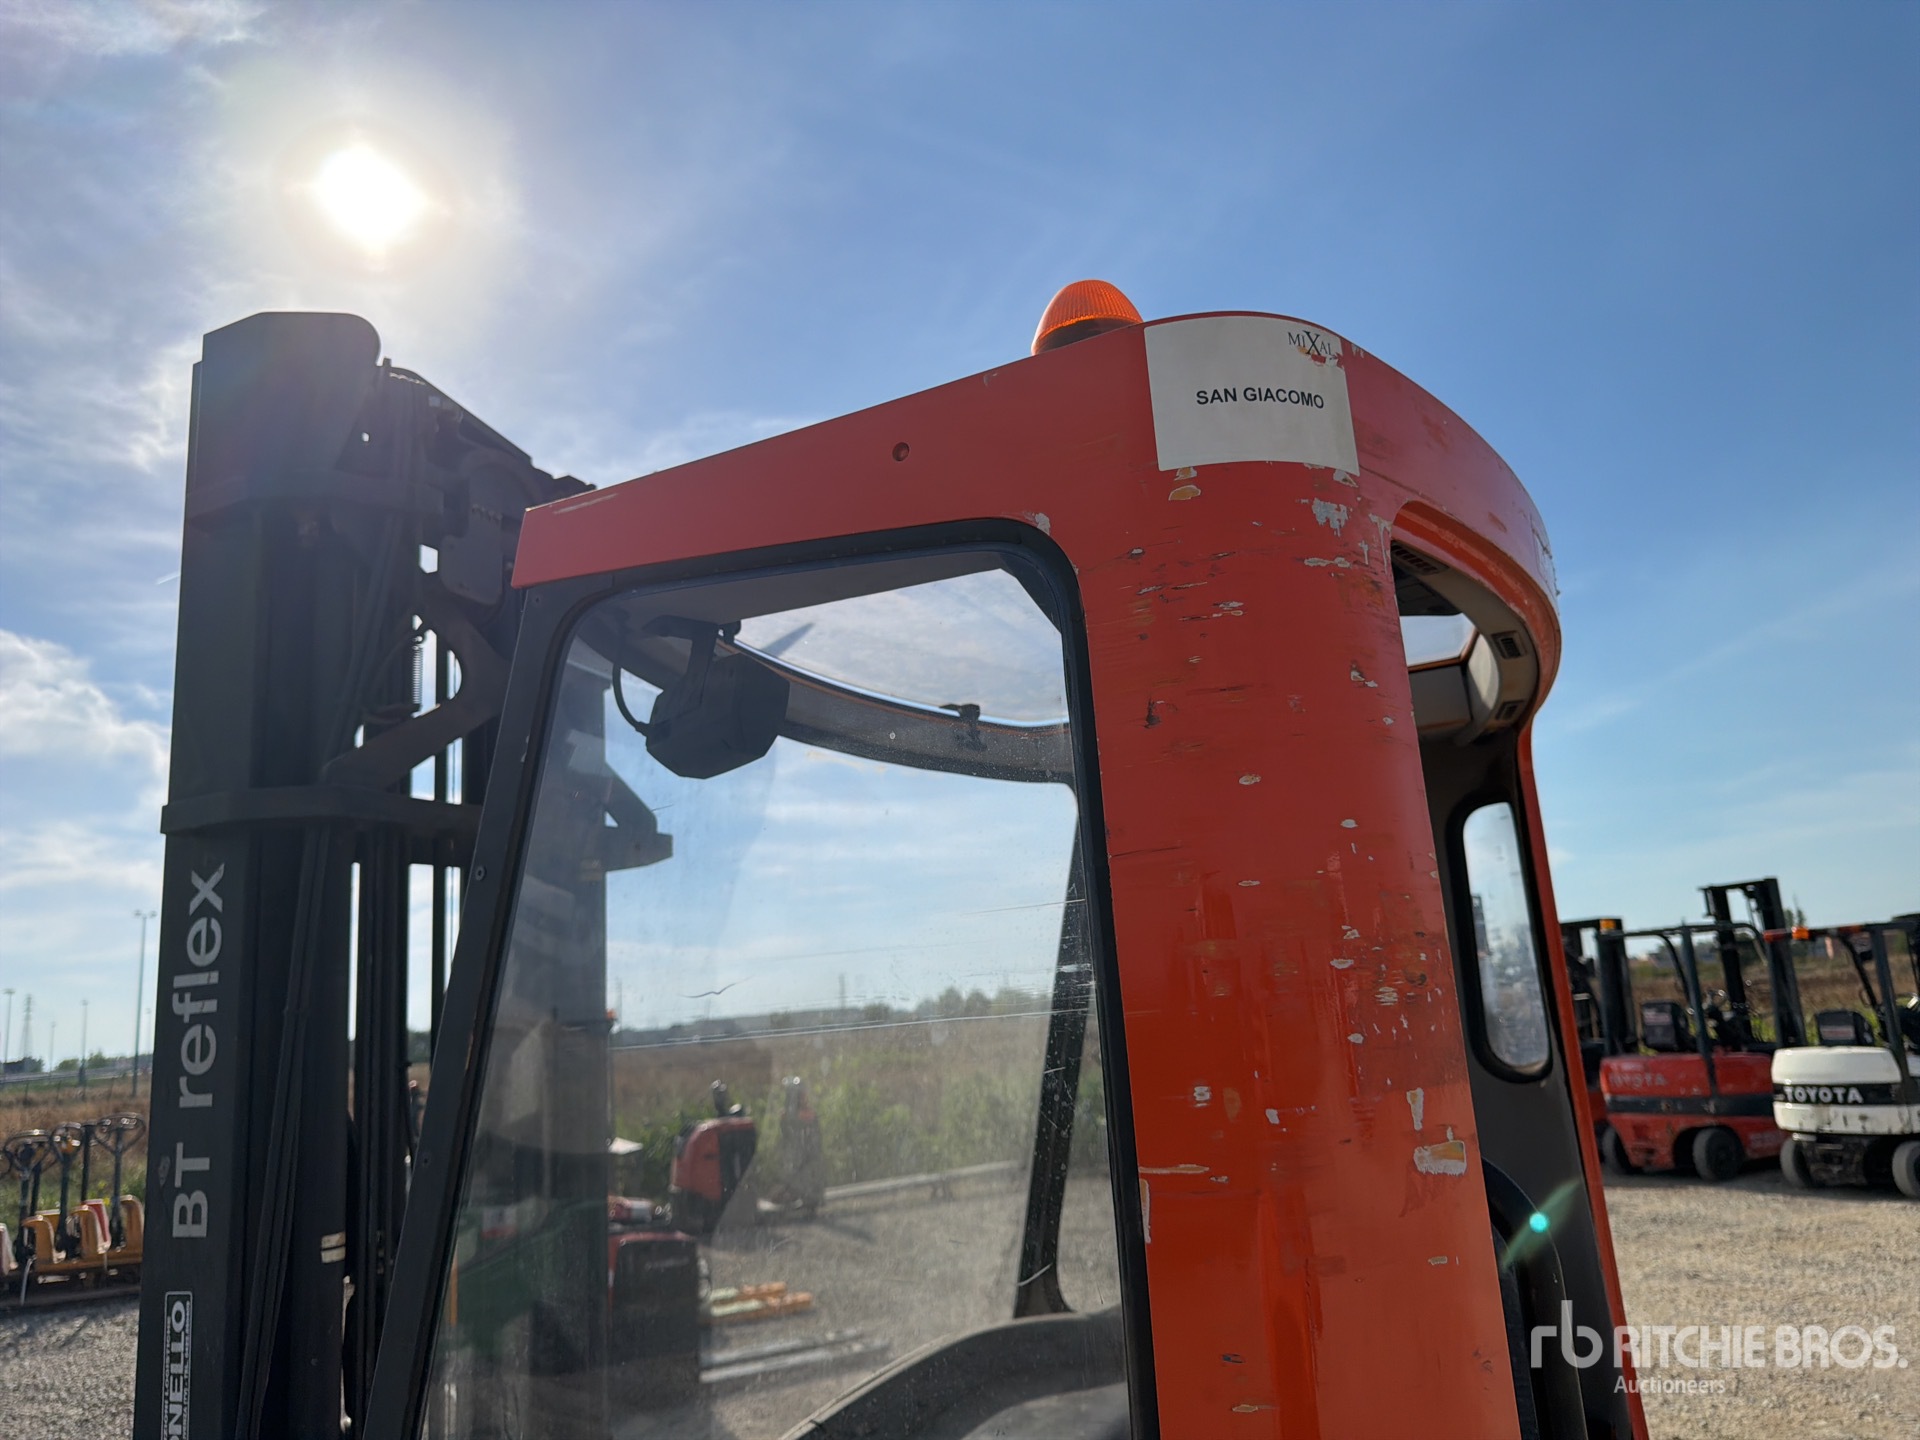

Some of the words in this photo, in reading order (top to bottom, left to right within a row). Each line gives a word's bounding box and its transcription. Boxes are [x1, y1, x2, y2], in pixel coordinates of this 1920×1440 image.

[1196, 388, 1237, 405] SAN
[1243, 387, 1324, 409] GIACOMO
[172, 862, 226, 1109] reflex
[1783, 1086, 1864, 1104] TOYOTA
[172, 1142, 212, 1239] BT
